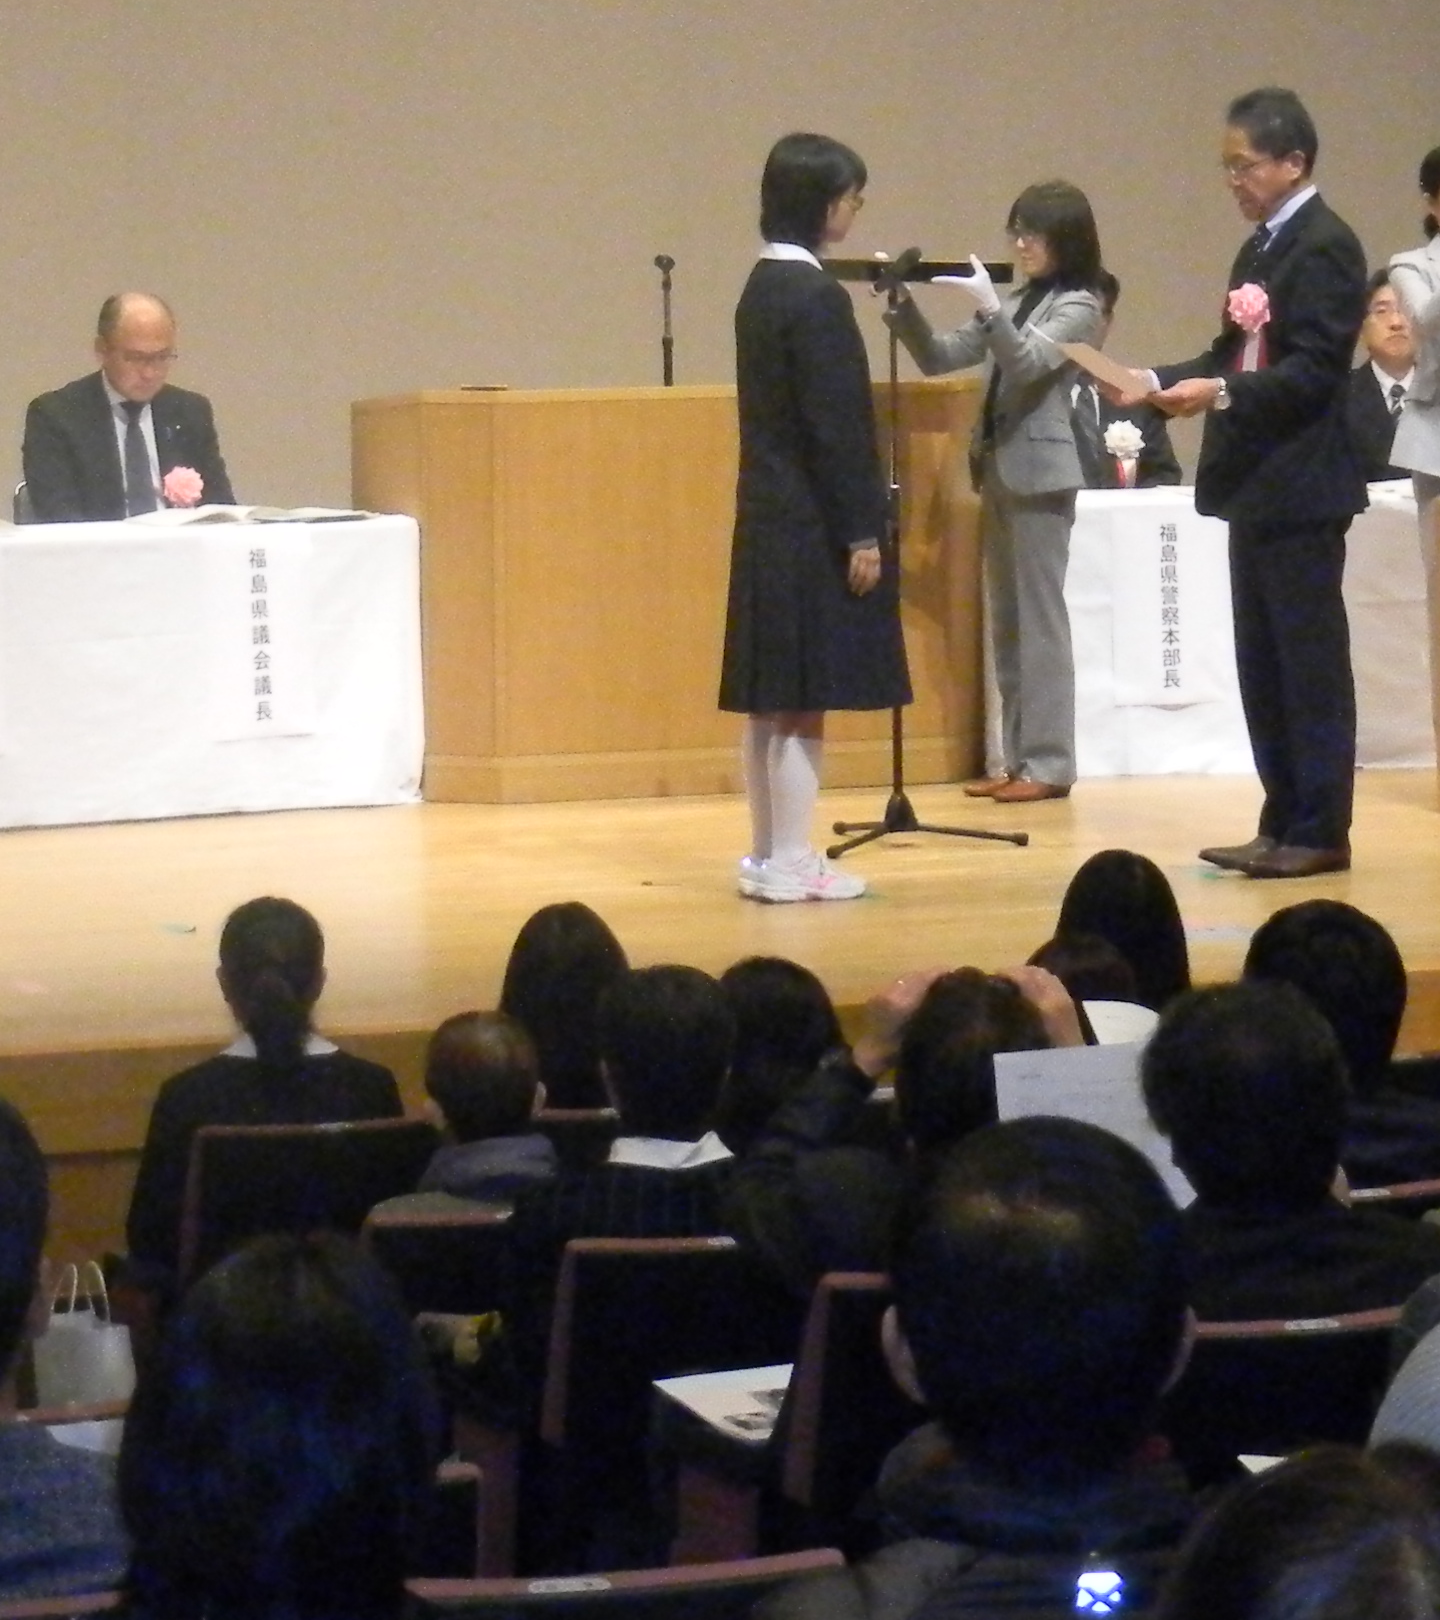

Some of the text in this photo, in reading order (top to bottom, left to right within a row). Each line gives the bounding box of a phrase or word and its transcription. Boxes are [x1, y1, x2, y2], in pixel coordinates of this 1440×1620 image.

[249, 548, 273, 722] 福島県議会議長
[1158, 522, 1181, 689] 福島県警察本部長
